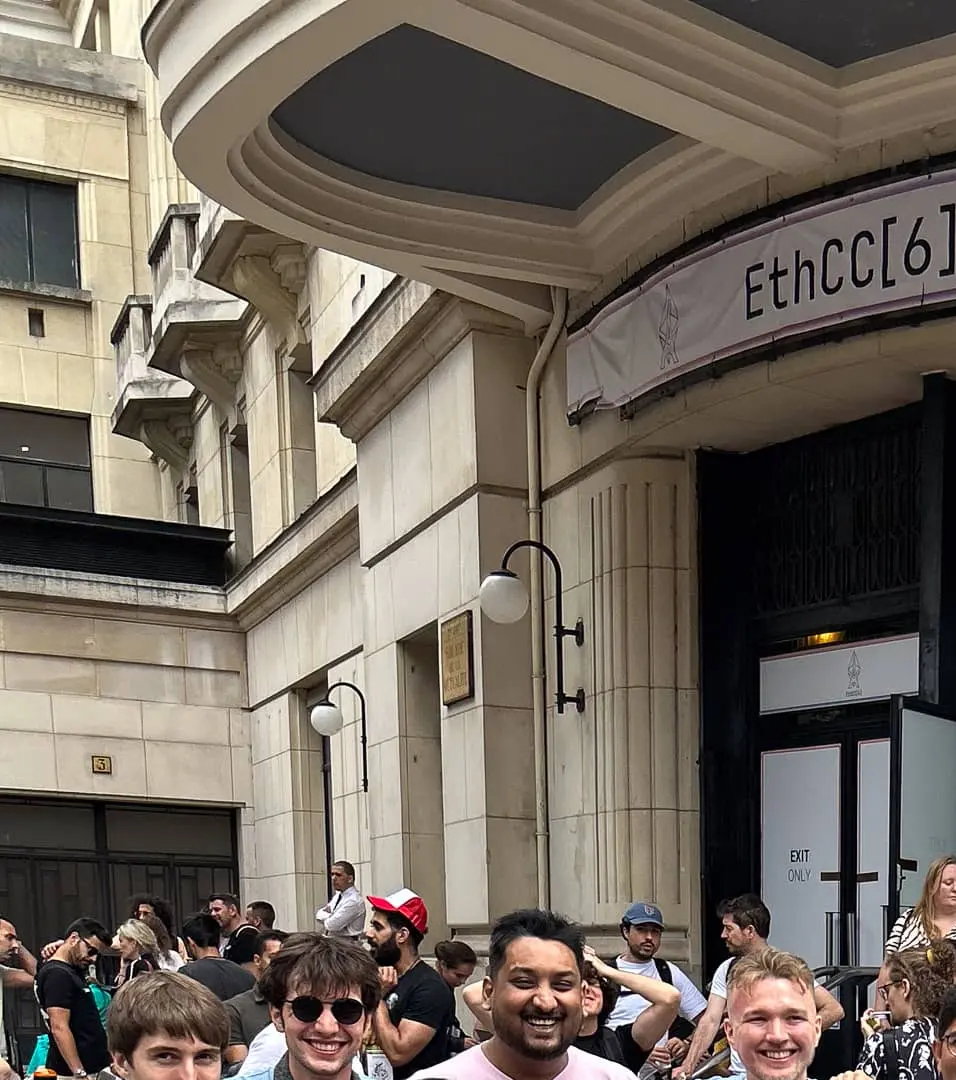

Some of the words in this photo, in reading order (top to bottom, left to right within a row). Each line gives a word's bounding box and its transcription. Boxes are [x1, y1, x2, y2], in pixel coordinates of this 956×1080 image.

[745, 203, 956, 320] EthCC[6]
[790, 849, 810, 863] EXIT
[788, 868, 811, 882] ONLY
